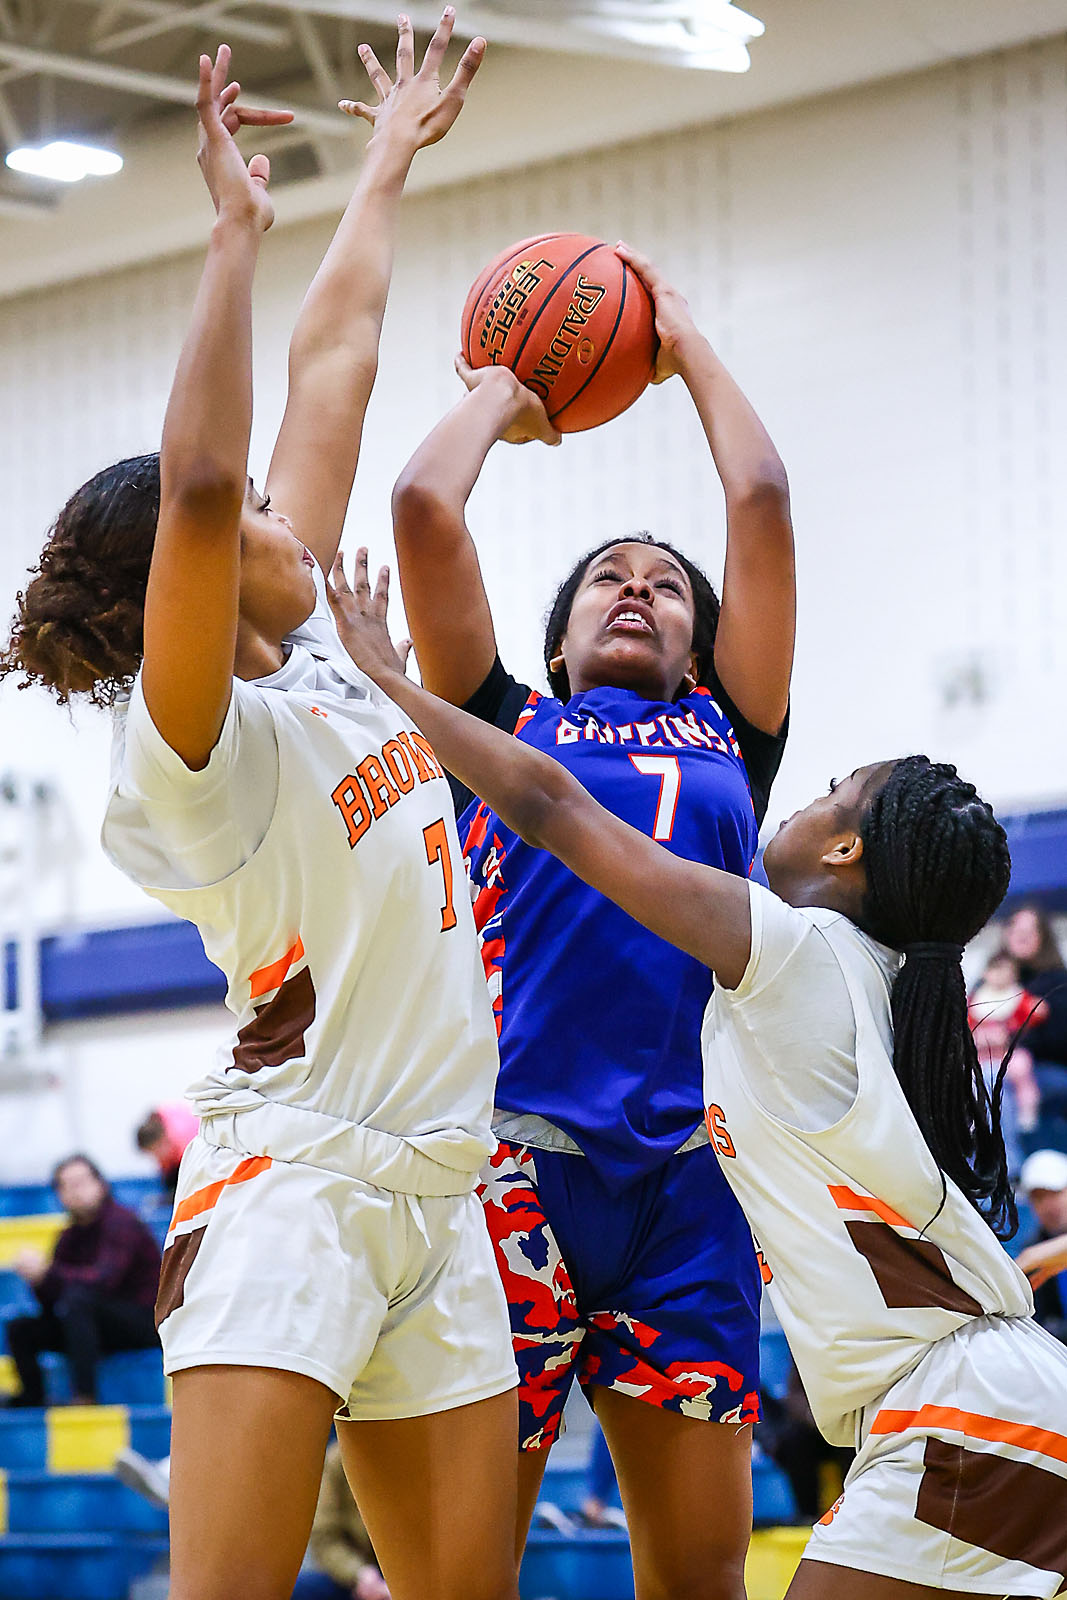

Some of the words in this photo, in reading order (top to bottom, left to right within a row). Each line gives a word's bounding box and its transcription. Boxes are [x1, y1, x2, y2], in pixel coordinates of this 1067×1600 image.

[488, 258, 556, 365] LEGACY
[523, 274, 607, 400] SPALDING
[628, 753, 681, 841] 7
[423, 817, 457, 933] 7
